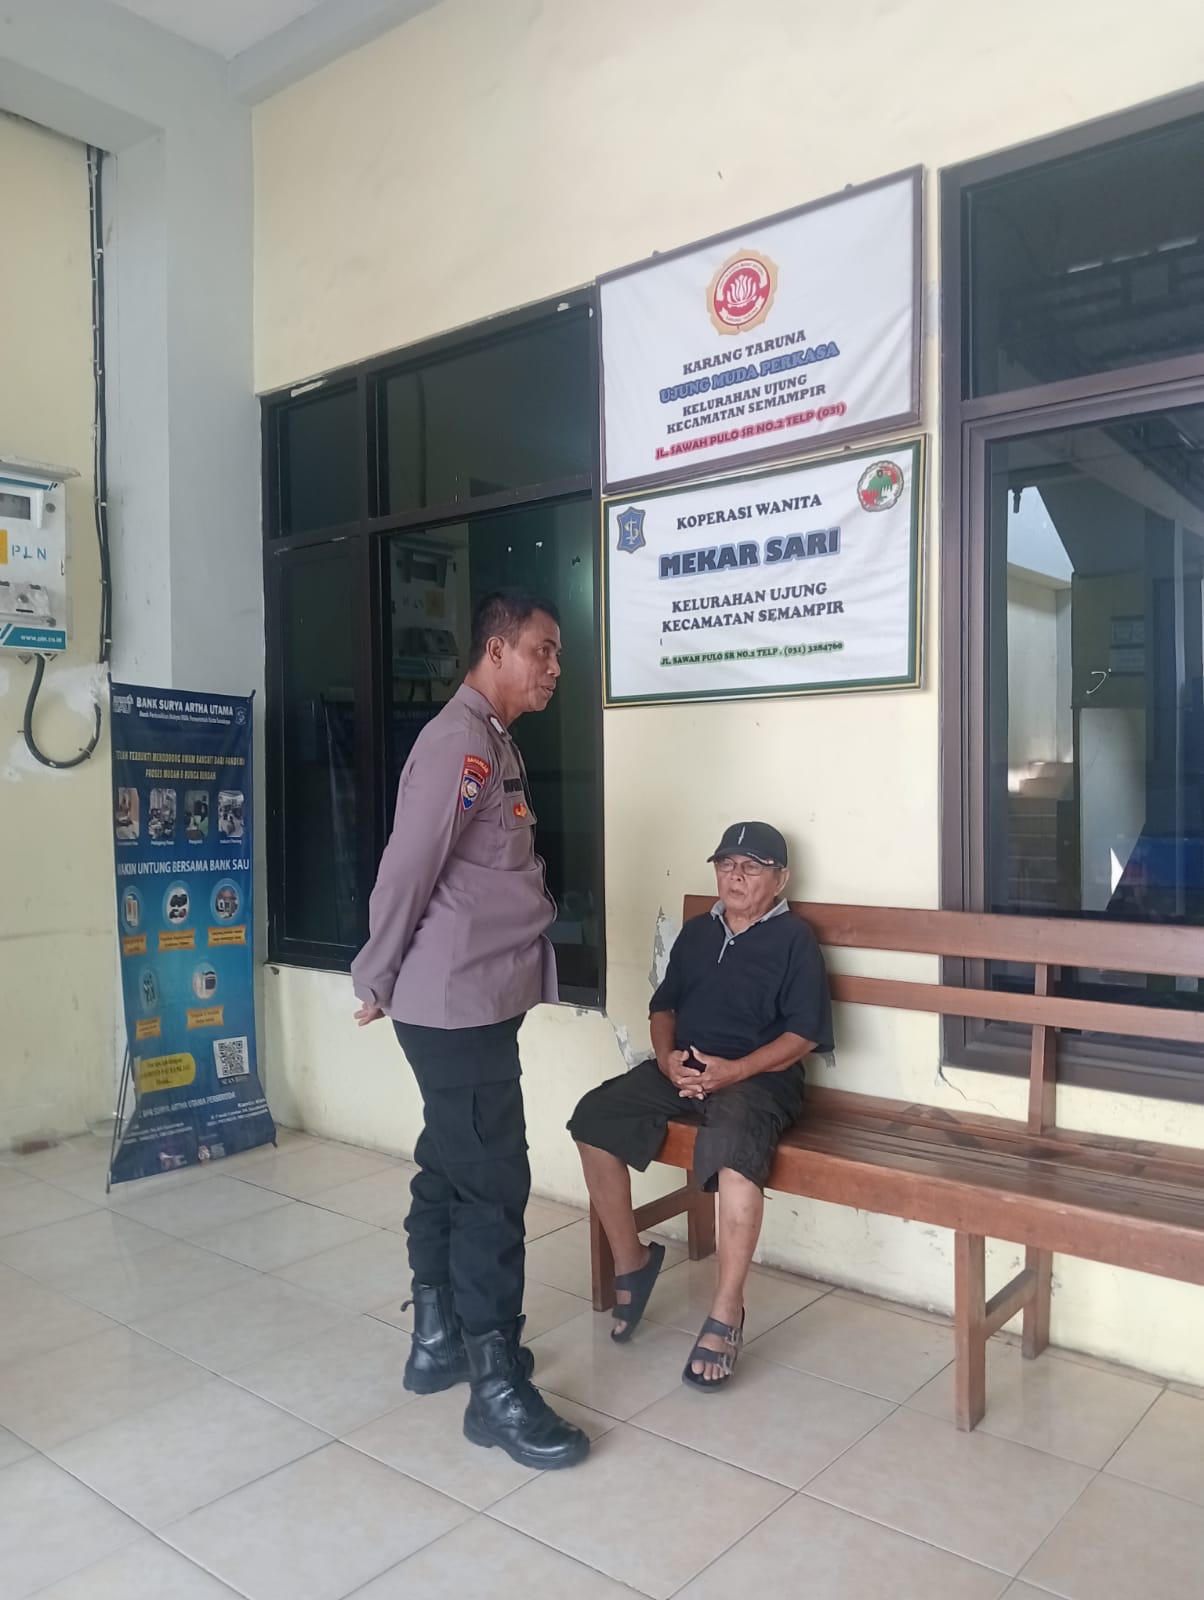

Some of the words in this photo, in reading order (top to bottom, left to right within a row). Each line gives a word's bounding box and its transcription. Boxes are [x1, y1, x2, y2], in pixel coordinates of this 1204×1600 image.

[659, 377, 710, 404] UJUNG
[711, 364, 759, 391] MUDA
[760, 341, 840, 377] PERKASA
[682, 349, 742, 375] KARANG
[745, 330, 806, 356] TARUNA
[666, 405, 745, 434] KECAMATAN
[748, 384, 826, 414] SEMAMPIR
[682, 387, 761, 417] KELURAHAN
[764, 374, 808, 396] UJUNG
[670, 437, 708, 456] SAWAH
[710, 431, 739, 447] PULO
[741, 427, 754, 441] SR
[755, 421, 784, 437] NO.2
[785, 411, 814, 427] TELP
[816, 402, 847, 421] (031)
[677, 505, 752, 530] KOPERASI
[756, 493, 822, 517] WANITA
[659, 540, 758, 580] MEKAR
[764, 527, 841, 564] SARI
[662, 611, 754, 633] KECAMATAN
[758, 601, 844, 622] SEMAMPIR
[672, 590, 766, 613] KELURAHAN
[770, 582, 827, 601] UJUNG
[673, 655, 700, 665] SAWAH
[702, 653, 722, 662] PULO
[784, 645, 806, 657] (031)
[136, 697, 158, 709] BANK
[158, 699, 183, 712] SURYA
[185, 702, 208, 714] ARTHA
[209, 705, 234, 716] UTAMA
[138, 861, 171, 874] UNTUNG
[172, 860, 208, 873] BERSAMA
[209, 859, 231, 871] BANK
[232, 858, 250, 870] SAU
